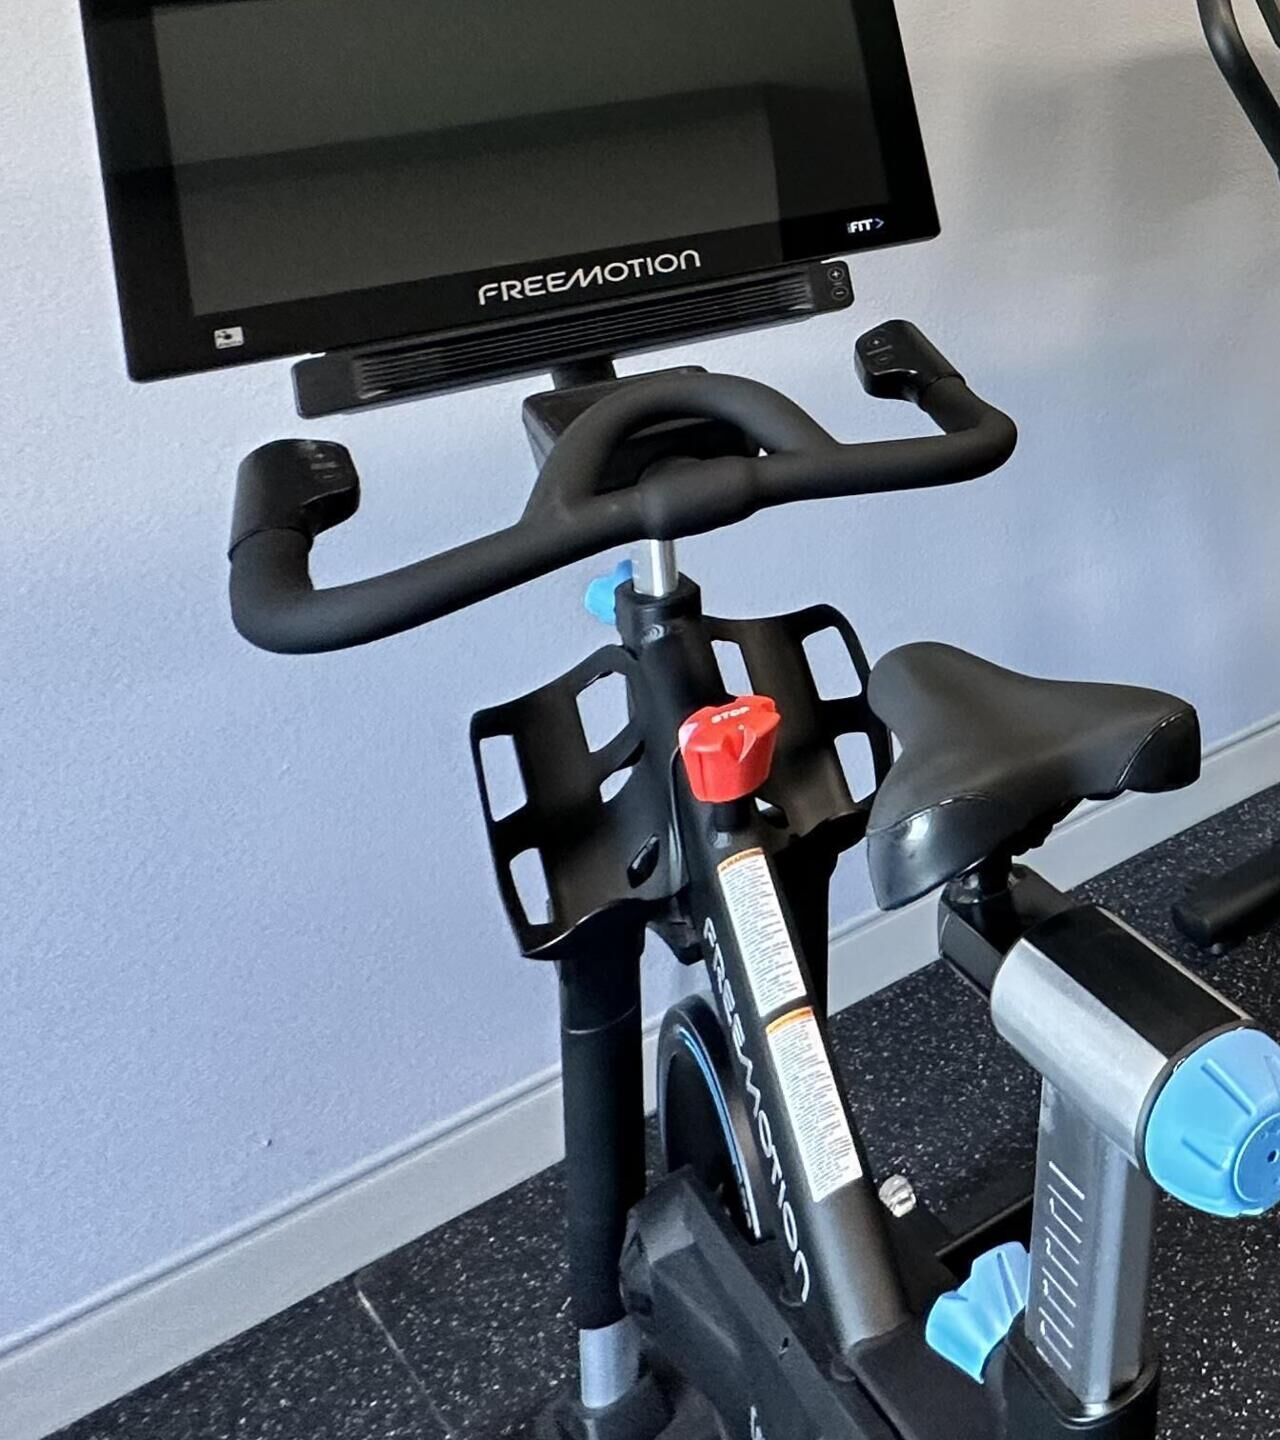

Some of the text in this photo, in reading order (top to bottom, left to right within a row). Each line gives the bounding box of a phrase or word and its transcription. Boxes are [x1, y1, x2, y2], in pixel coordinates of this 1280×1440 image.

[478, 249, 702, 306] FREEMOTION
[711, 705, 751, 725] STOP
[703, 916, 811, 1304] FREEMOTION
